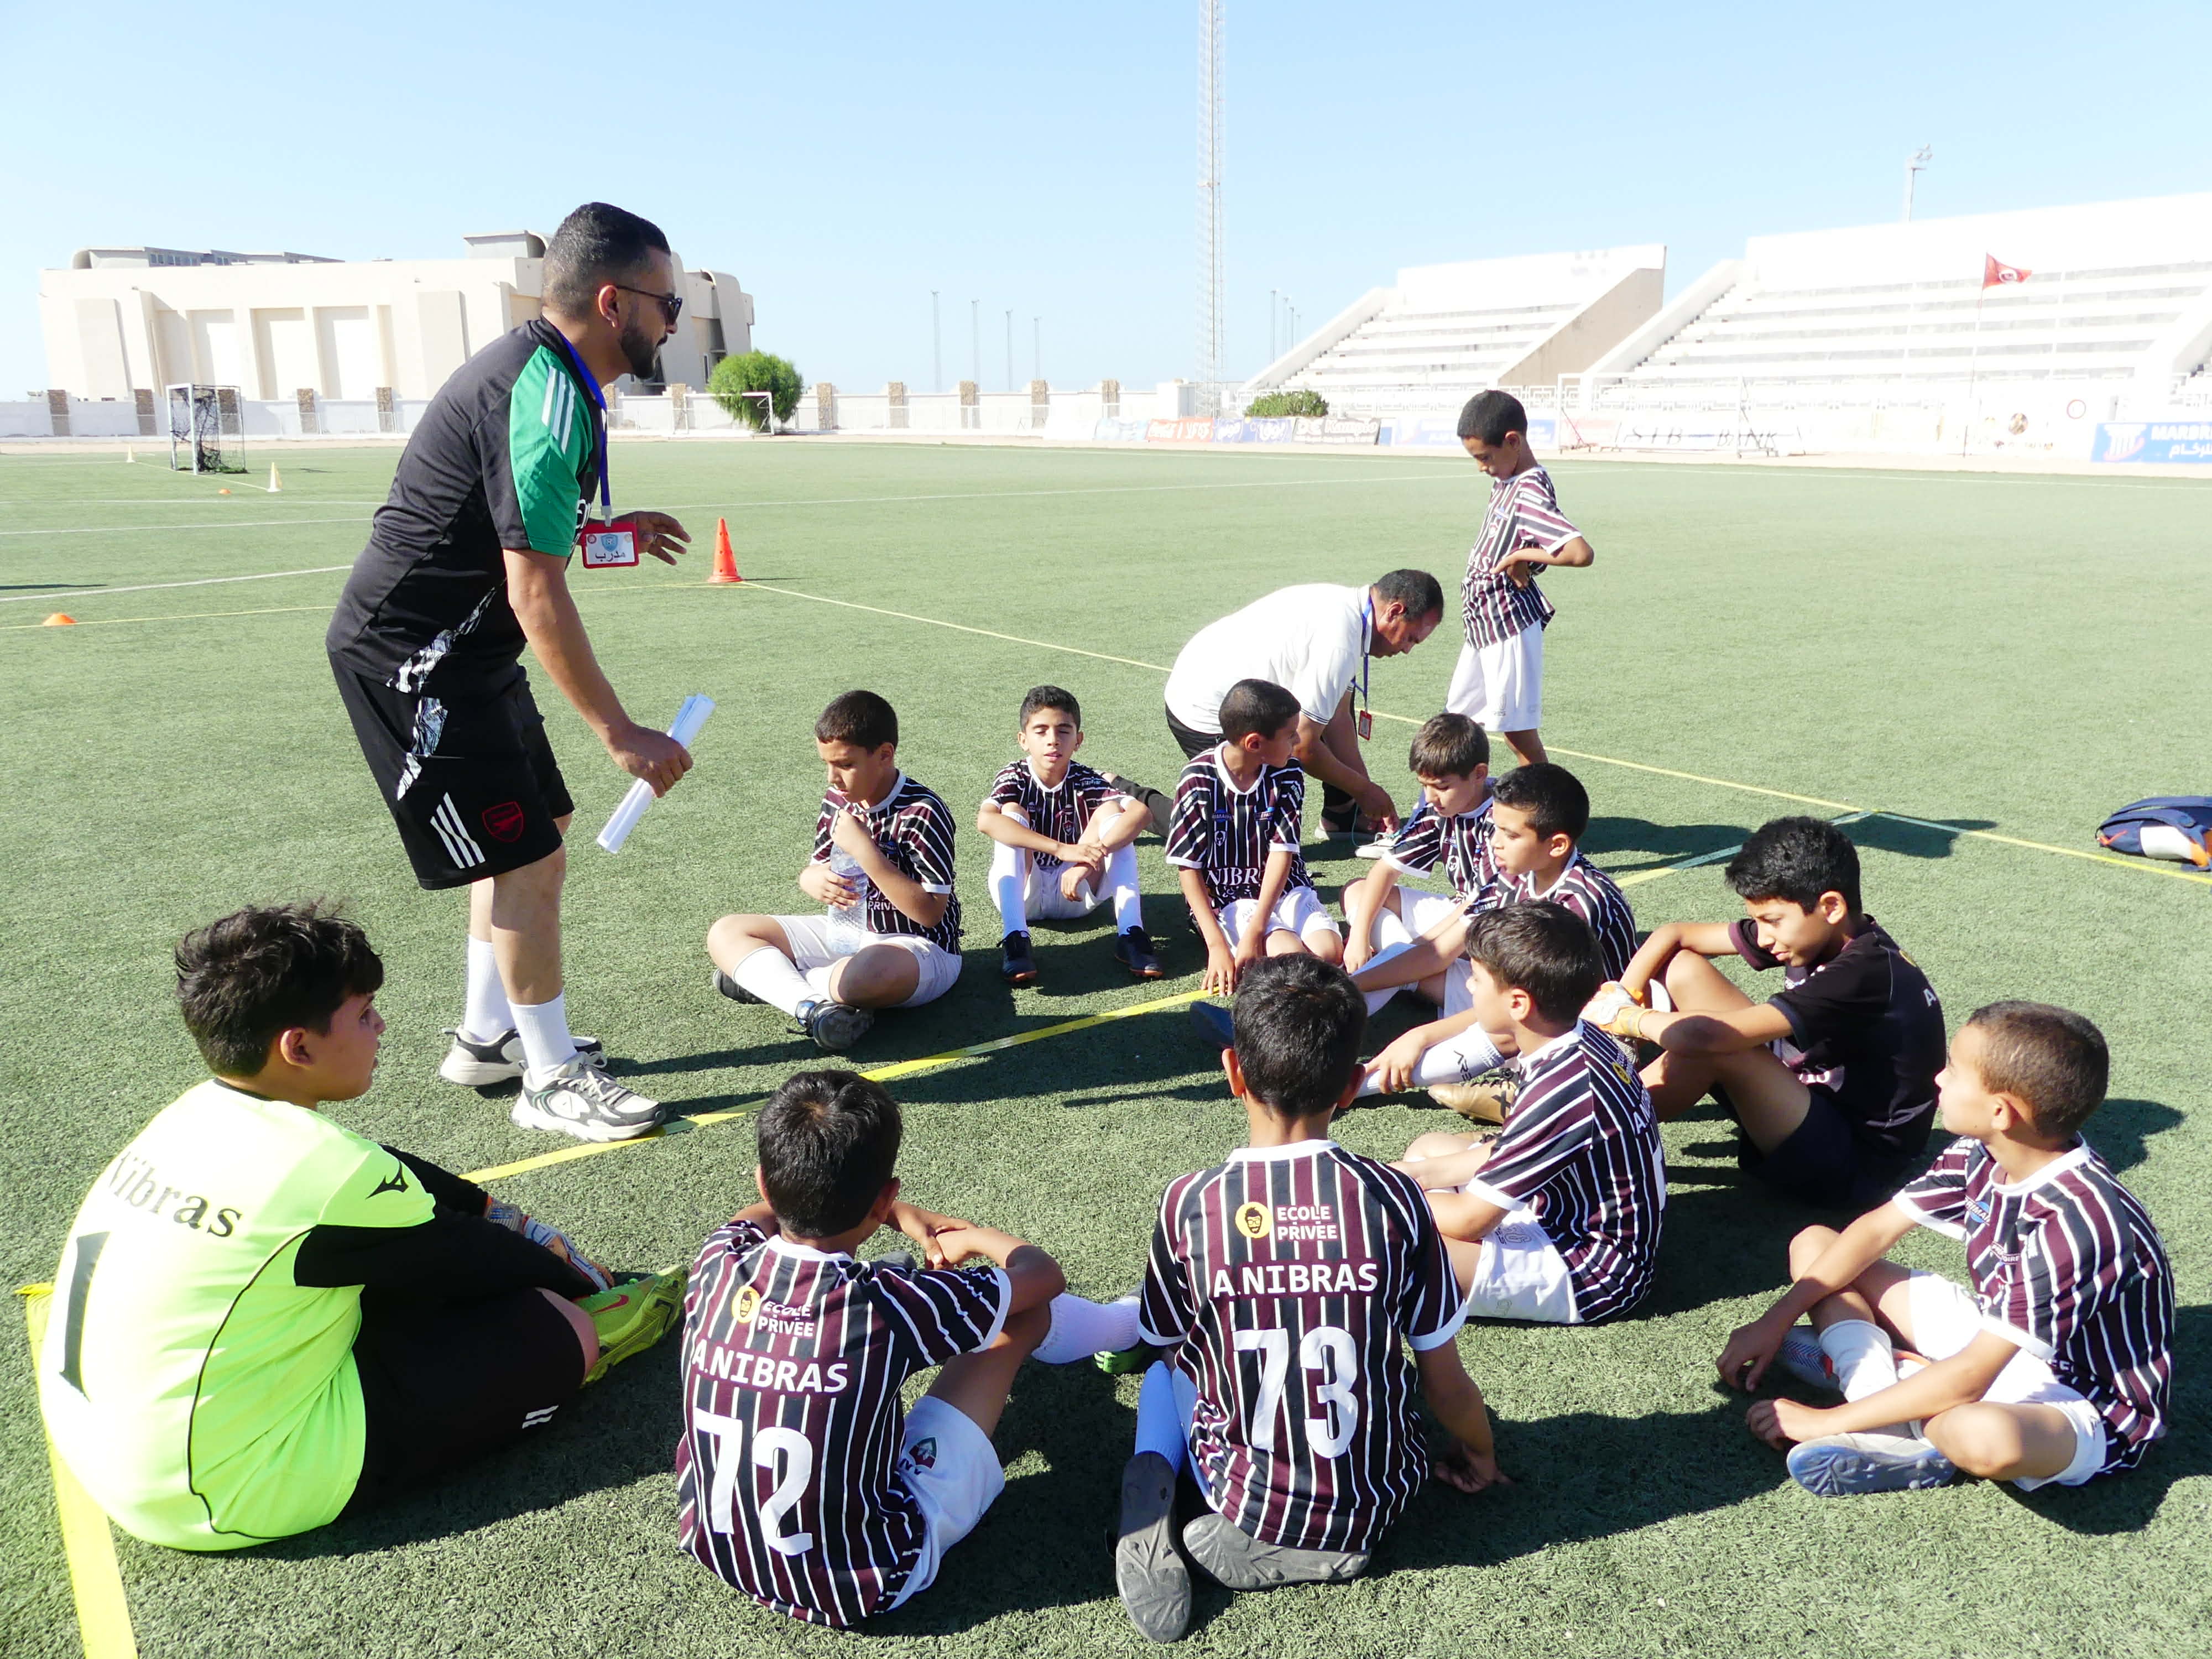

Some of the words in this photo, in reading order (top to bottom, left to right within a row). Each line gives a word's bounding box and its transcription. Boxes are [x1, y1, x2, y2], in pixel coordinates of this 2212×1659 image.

[2151, 425, 2212, 440] MARBR
[594, 550, 625, 562] مدرب
[1206, 867, 1259, 886] NIBR
[868, 900, 898, 911] PRIV
[1277, 1206, 1331, 1221] ECOLE
[1213, 1263, 1378, 1298] A.NIBRAS
[763, 1301, 811, 1317] ECOLE
[692, 1339, 848, 1393] A.NIBRAS
[1232, 1326, 1359, 1459] 73
[692, 1406, 813, 1556] 72
